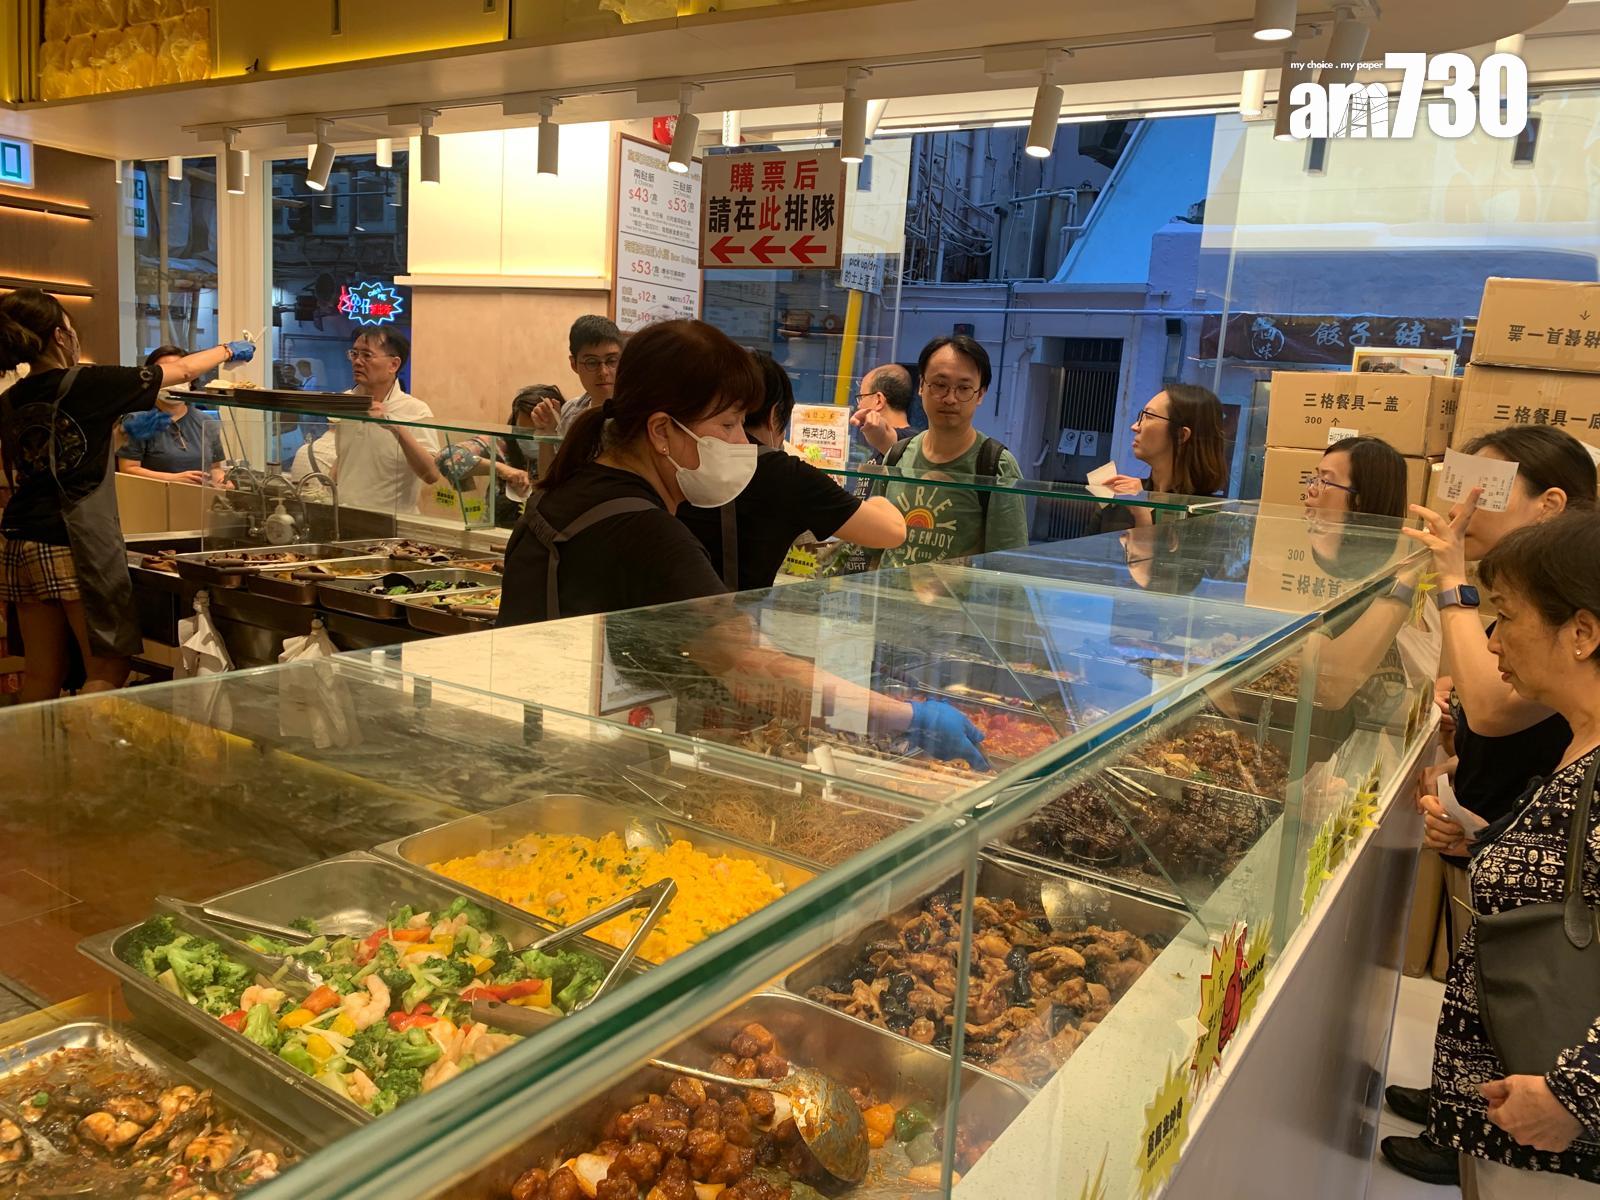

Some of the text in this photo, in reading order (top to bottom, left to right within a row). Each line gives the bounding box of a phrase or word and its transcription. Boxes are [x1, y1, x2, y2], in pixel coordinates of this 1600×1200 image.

[730, 159, 819, 192] 購票后
[708, 193, 835, 233] 請在此排隊
[1303, 393, 1399, 412] 三格餐具一盖
[1304, 416, 1322, 425] 300
[896, 486, 957, 531] URLEY
[918, 530, 954, 549] ENJOY
